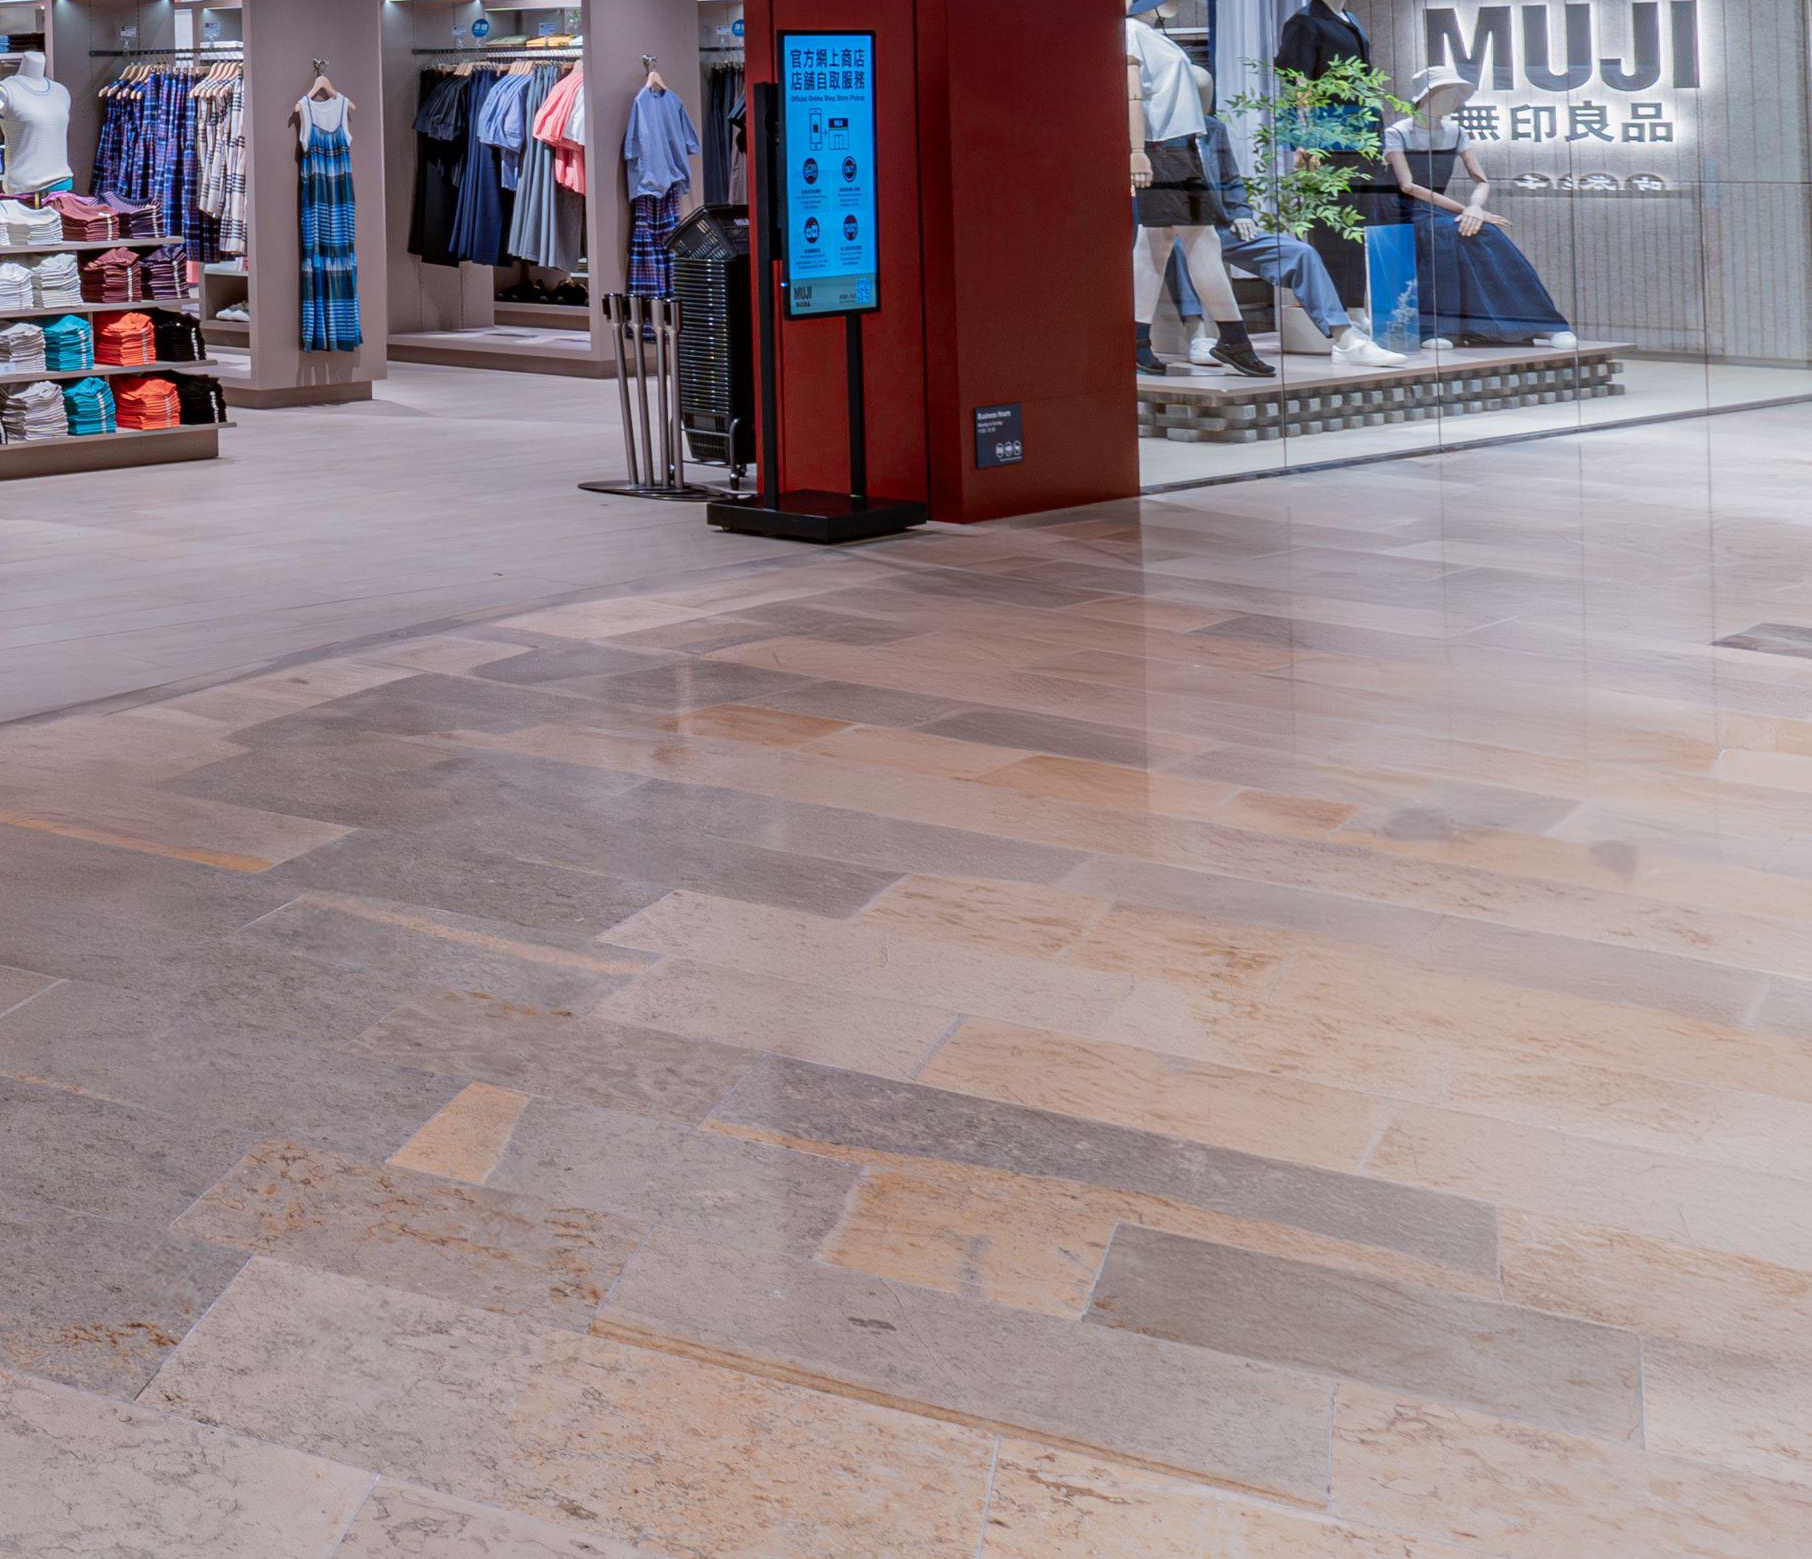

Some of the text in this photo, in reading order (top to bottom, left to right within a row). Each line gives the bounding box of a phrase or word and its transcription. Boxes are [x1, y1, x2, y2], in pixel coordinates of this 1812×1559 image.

[790, 48, 865, 68] 官方網上商店
[1426, 0, 1701, 91] MUJI
[1452, 100, 1674, 142] 無印良品
